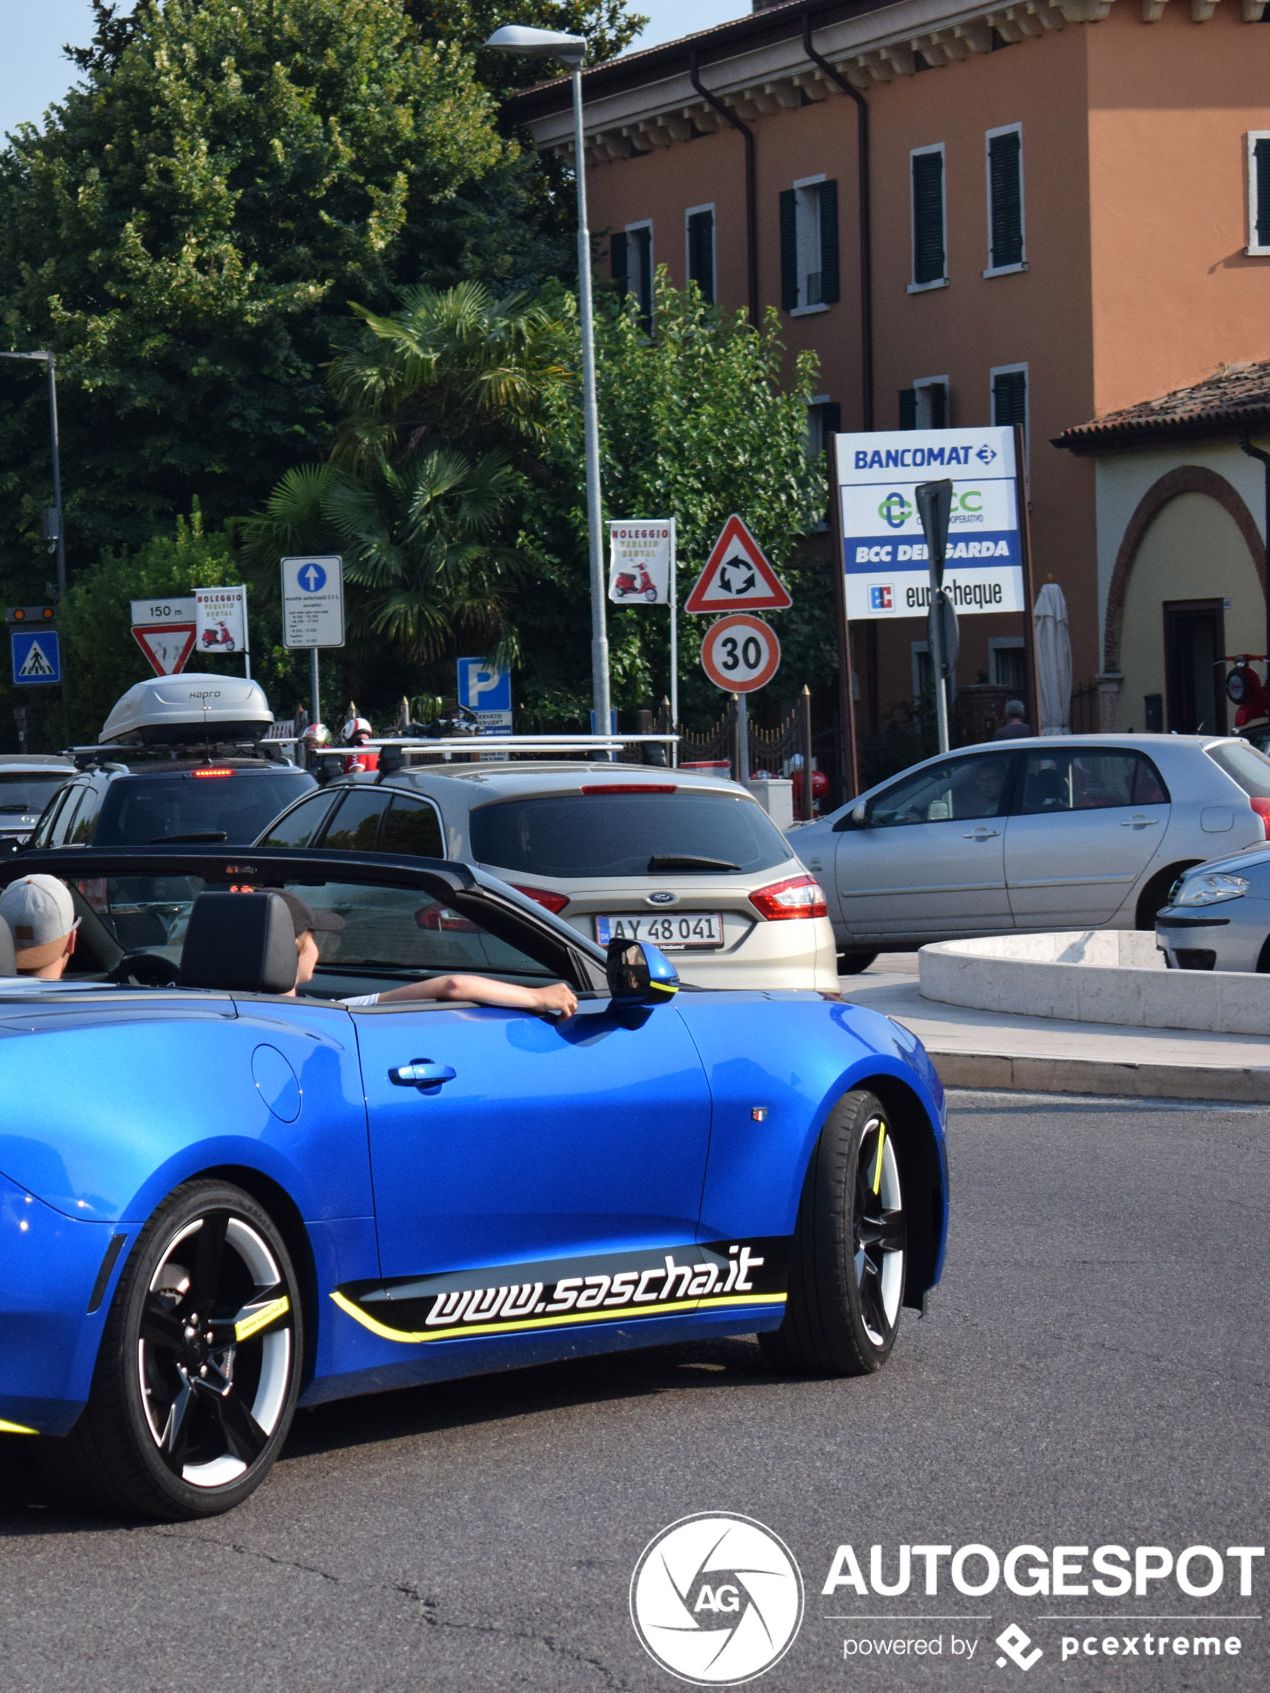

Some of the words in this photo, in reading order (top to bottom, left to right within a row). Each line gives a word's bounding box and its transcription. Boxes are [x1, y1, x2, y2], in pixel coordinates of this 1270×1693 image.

[855, 446, 973, 469] BANCOMAT
[612, 529, 669, 538] NOLEGGIO
[855, 545, 892, 563] BCC
[197, 594, 242, 603] NOLEGGIO
[906, 579, 1002, 609] eurcheque
[150, 606, 171, 617] 150
[721, 636, 762, 671] 30
[467, 663, 500, 707] P
[614, 919, 641, 940] AY
[648, 918, 673, 940] 48
[680, 918, 716, 940] 041
[424, 1245, 765, 1326] www.sascha.it
